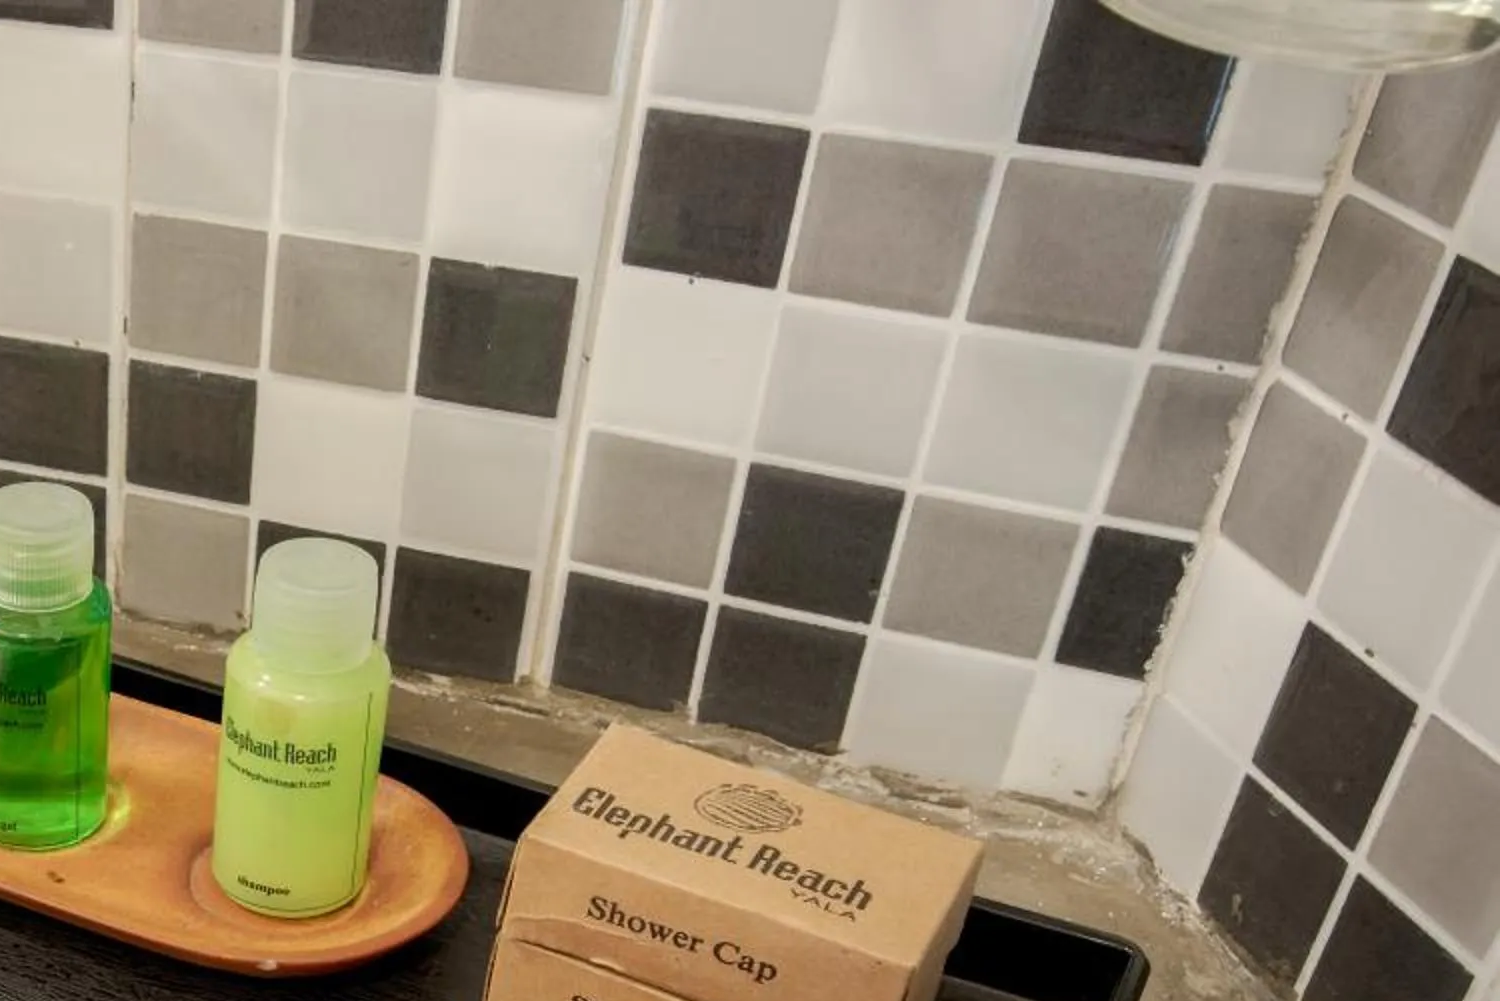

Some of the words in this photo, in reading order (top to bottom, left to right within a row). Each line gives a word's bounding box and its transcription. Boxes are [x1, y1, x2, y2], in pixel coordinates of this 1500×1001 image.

[225, 716, 281, 762] Elephant
[285, 742, 337, 765] Reach
[571, 786, 744, 865] Elephant
[746, 843, 874, 911] Reach
[789, 887, 857, 922] YALA
[585, 895, 706, 955] Shower
[712, 940, 780, 984] Cap
